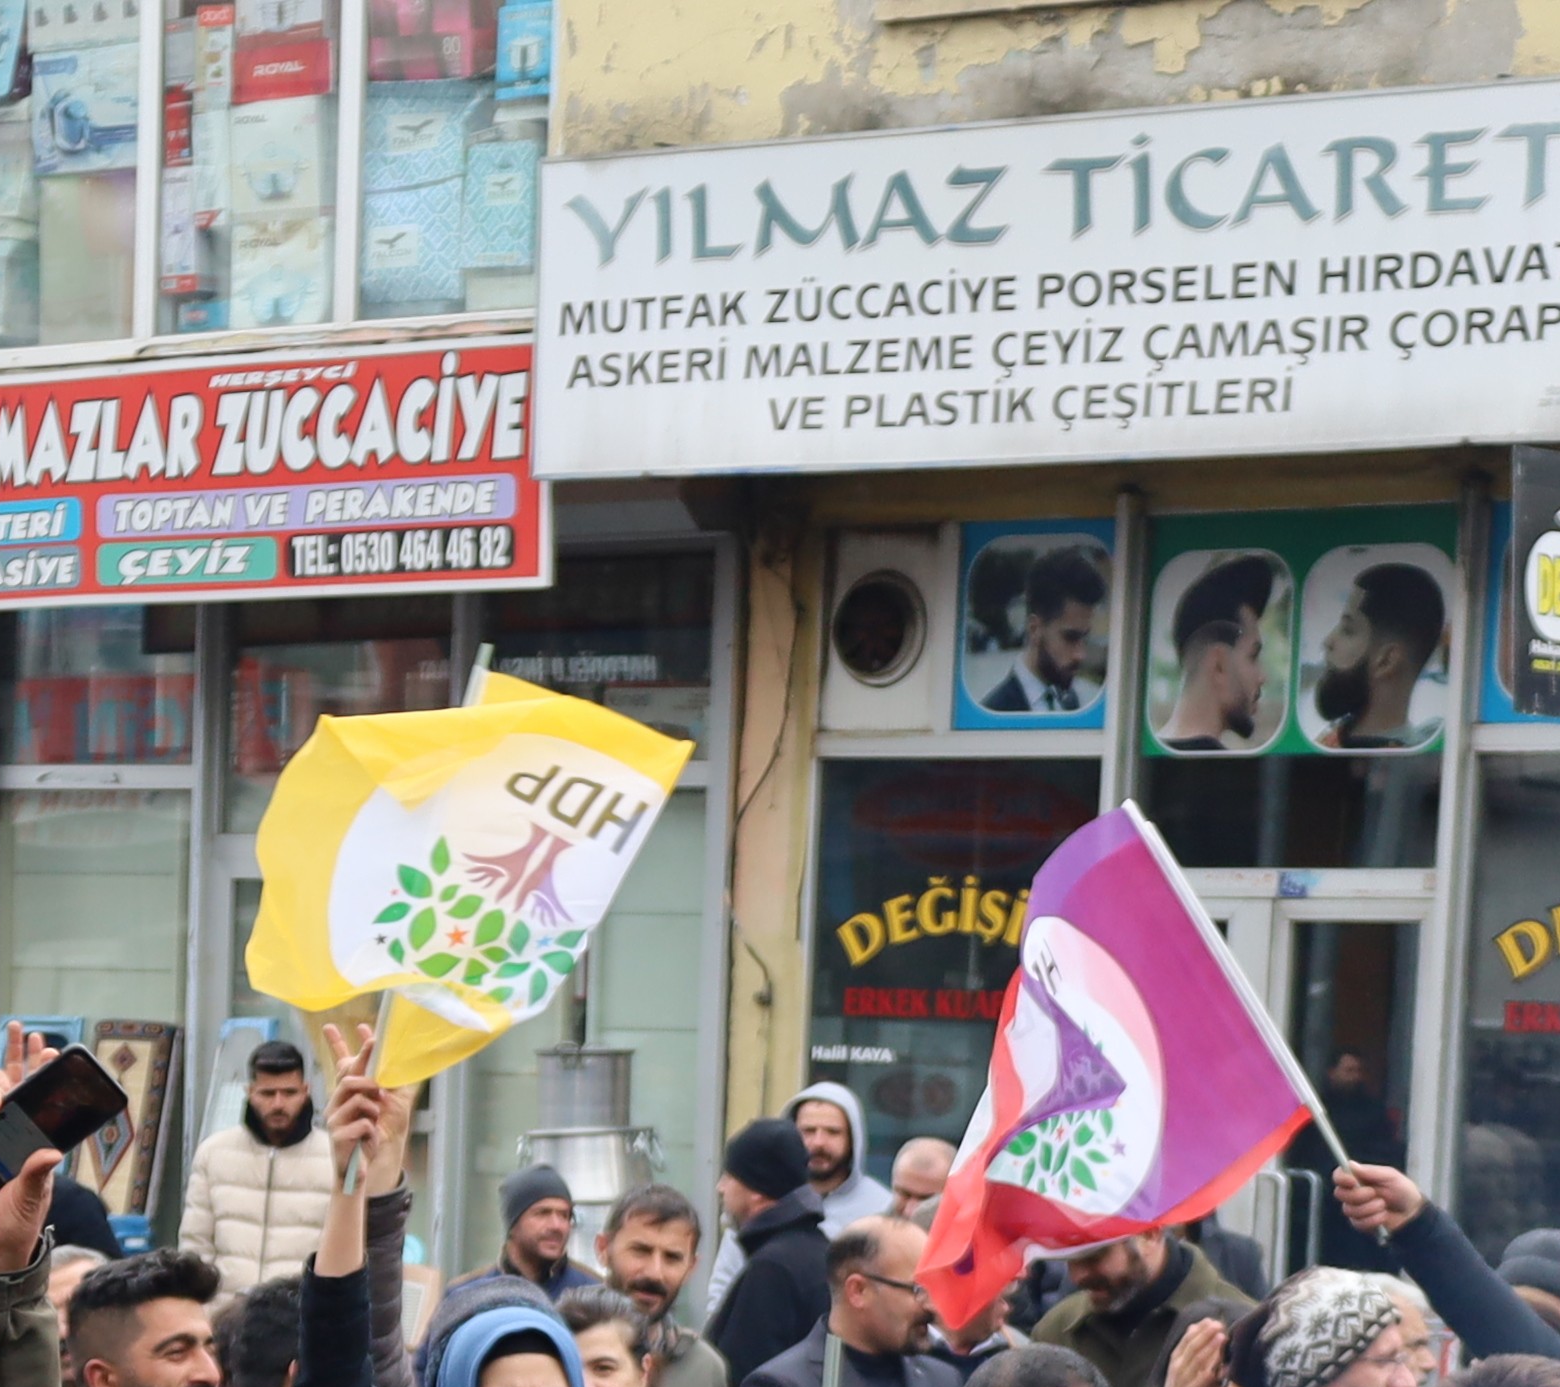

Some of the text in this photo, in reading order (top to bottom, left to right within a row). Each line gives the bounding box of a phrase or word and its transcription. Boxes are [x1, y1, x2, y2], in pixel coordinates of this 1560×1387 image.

[253, 59, 307, 78] ROYAL
[442, 36, 461, 55] 80
[562, 170, 1011, 268] YILMAZ
[559, 290, 747, 336] MUTFAK
[762, 270, 1018, 324] ZÜCCACİYE
[1037, 260, 1297, 309] PORSELEN
[209, 360, 358, 388] HERŞEYCİ
[566, 336, 730, 389] ASKERİ
[742, 334, 973, 379] MALZEME
[992, 318, 1123, 379] ÇEYİZ
[1143, 314, 1370, 371] ÇAMAŞIR
[769, 368, 1294, 431] VE PLASTİK ÇEŞİTLERİ
[114, 481, 498, 532] TOPTAN VE PERAKENDE
[117, 538, 252, 587] ÇEYİZ
[292, 525, 509, 576] TEL: 0530 464 46 82
[505, 763, 650, 855] HDP
[836, 875, 1032, 967] DEĞİŞİ
[842, 987, 932, 1018] ERKEK
[811, 1044, 894, 1063] Halil KAYA
